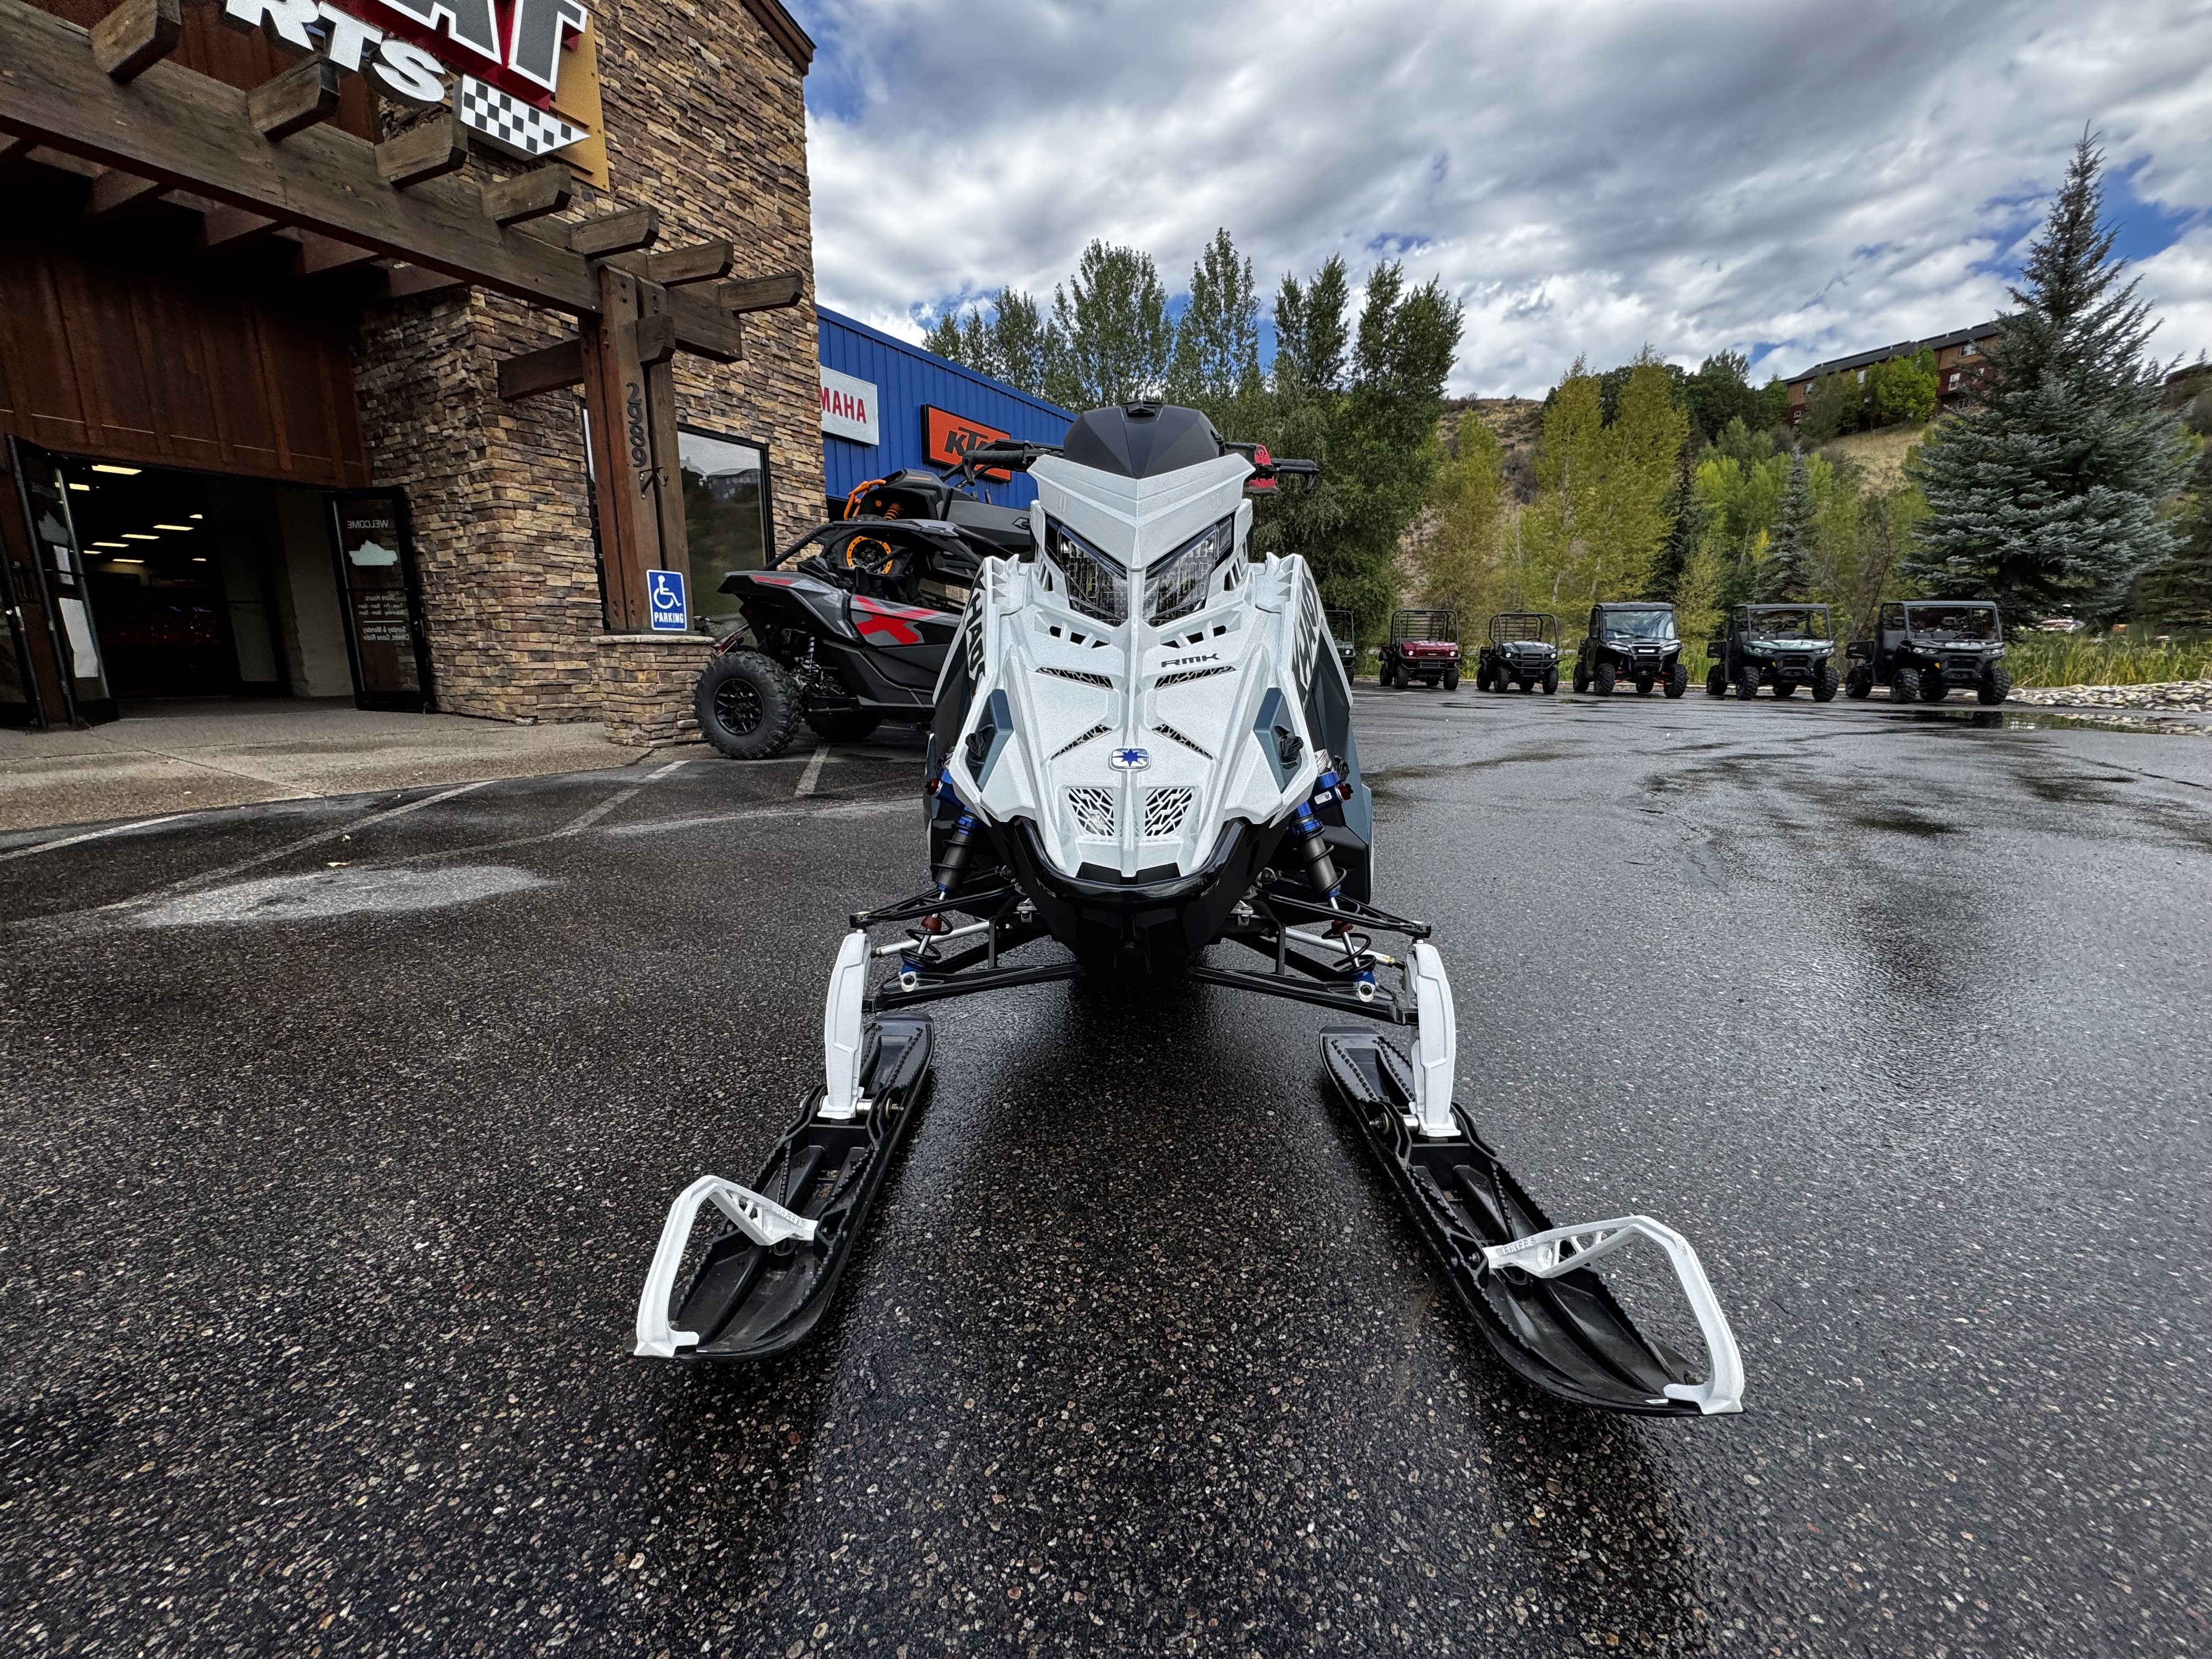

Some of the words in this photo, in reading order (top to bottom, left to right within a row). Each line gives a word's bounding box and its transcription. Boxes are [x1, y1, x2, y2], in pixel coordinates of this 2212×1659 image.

[626, 382, 647, 467] 2989
[944, 426, 989, 456] KT
[654, 612, 684, 623] PARKING
[1161, 653, 1221, 668] RMK
